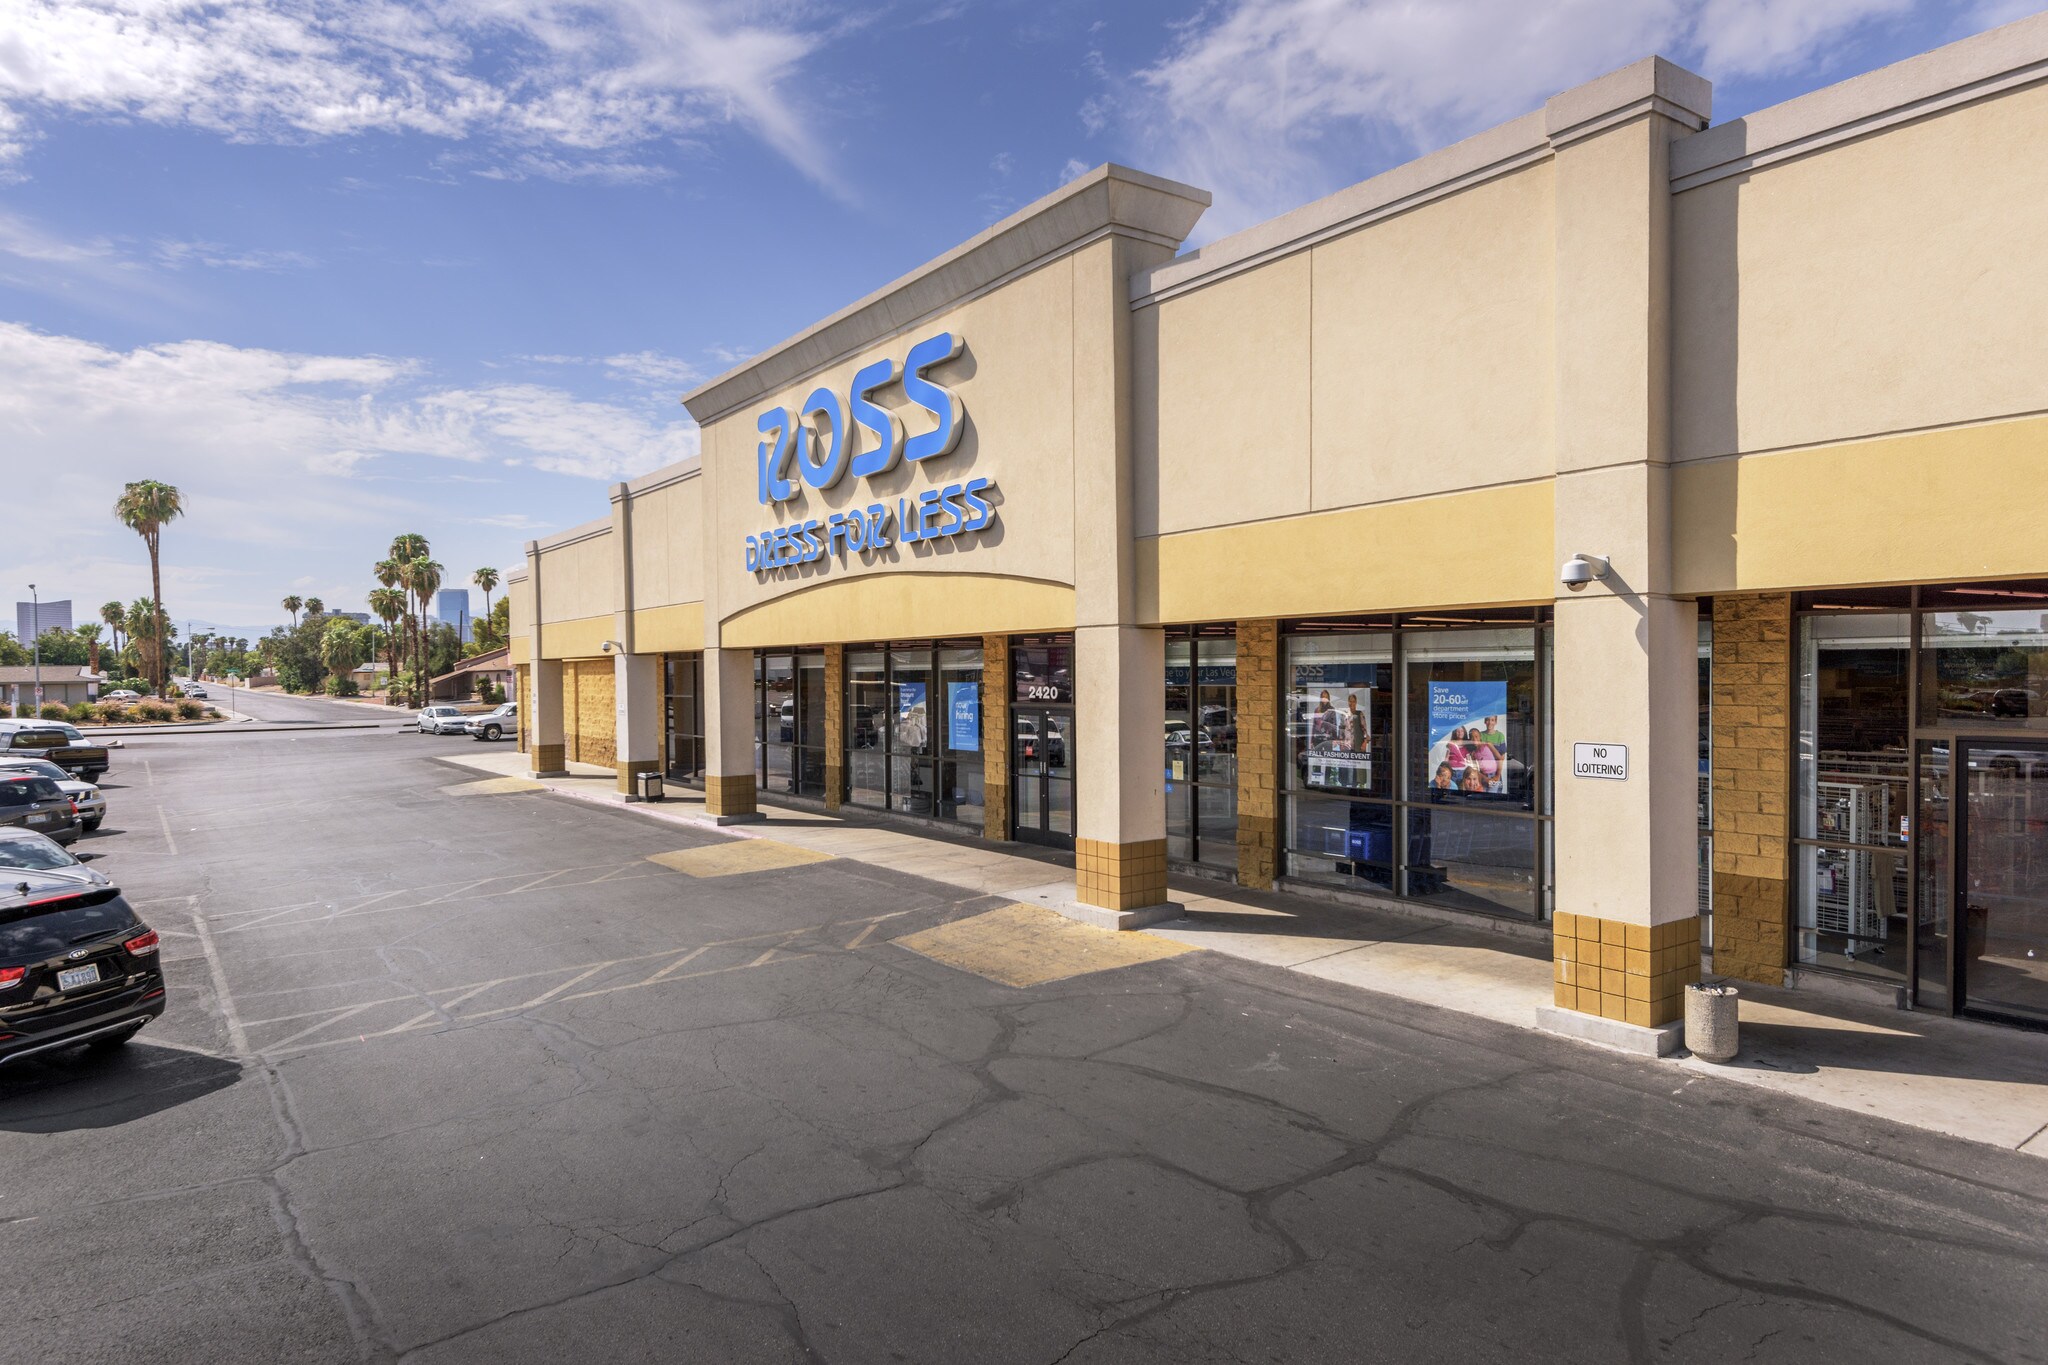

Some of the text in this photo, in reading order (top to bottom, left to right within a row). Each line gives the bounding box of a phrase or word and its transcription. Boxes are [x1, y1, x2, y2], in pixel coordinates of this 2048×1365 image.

[757, 332, 958, 506] ROSS
[746, 478, 989, 572] DRESS FOR LESS
[1175, 669, 1184, 677] to
[1206, 667, 1218, 677] Las
[1028, 686, 1059, 700] 2420
[955, 711, 974, 723] hiring
[1593, 748, 1607, 758] NO
[1577, 763, 1624, 775] LOITERING
